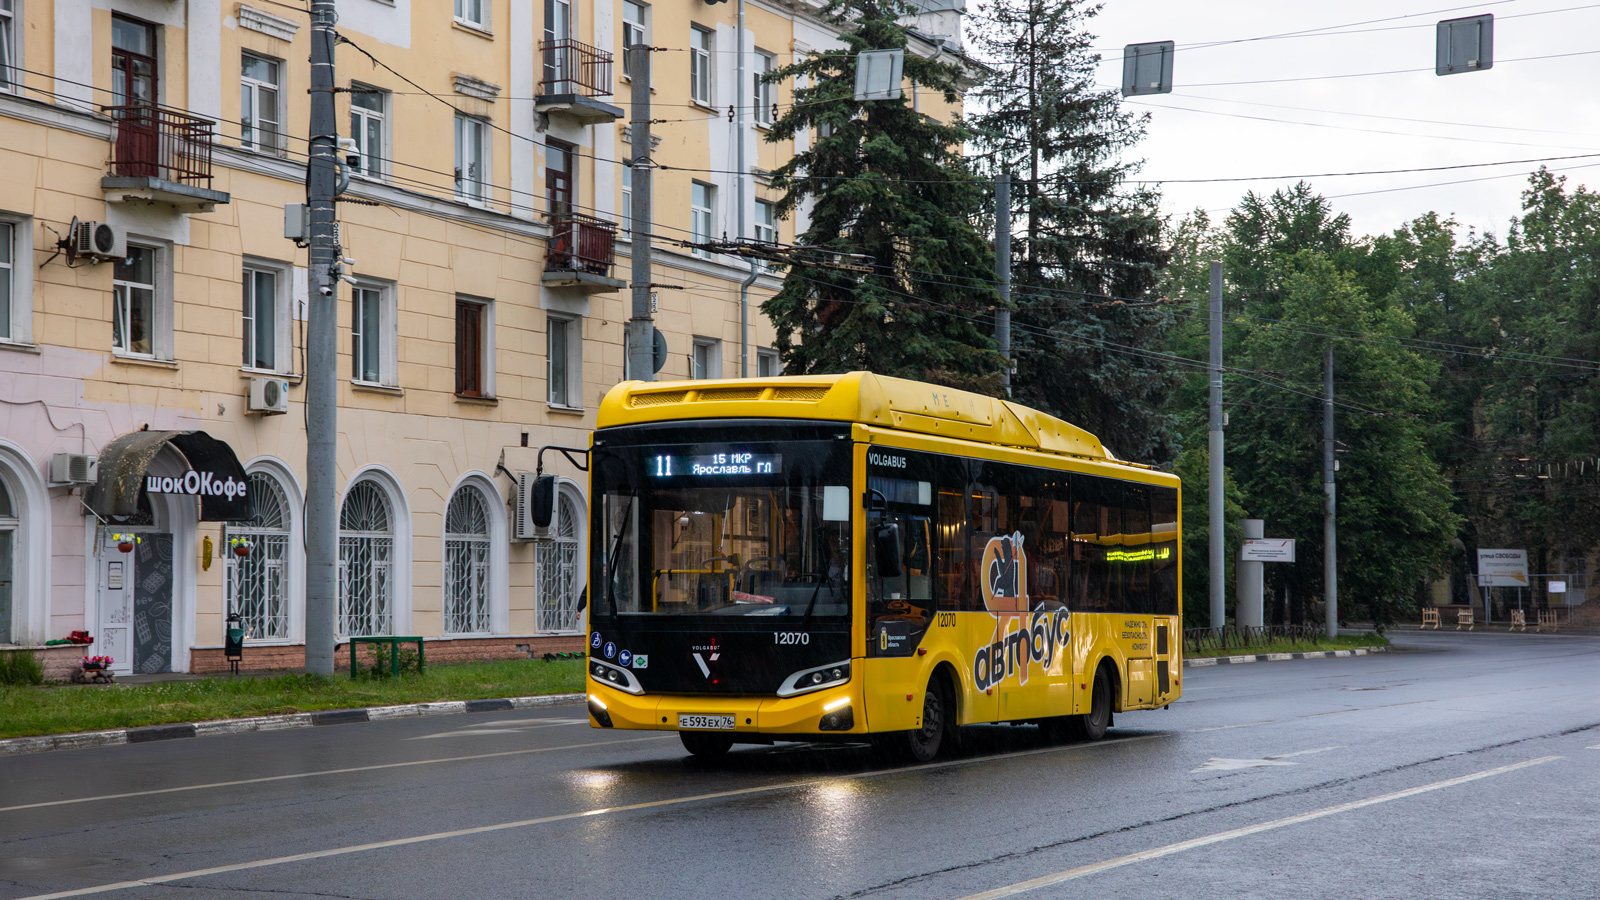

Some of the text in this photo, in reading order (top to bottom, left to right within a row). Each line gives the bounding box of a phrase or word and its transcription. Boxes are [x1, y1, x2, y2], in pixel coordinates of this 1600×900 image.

[656, 455, 672, 477] 11
[713, 453, 752, 464] 15 МКР
[868, 452, 907, 469] VOLGABUS
[692, 464, 752, 476] Ярославль
[146, 470, 247, 502] шокОКофе
[937, 612, 956, 628] 12070
[773, 632, 810, 645] 12070
[974, 602, 1070, 692] автобус
[722, 717, 732, 725] 76
